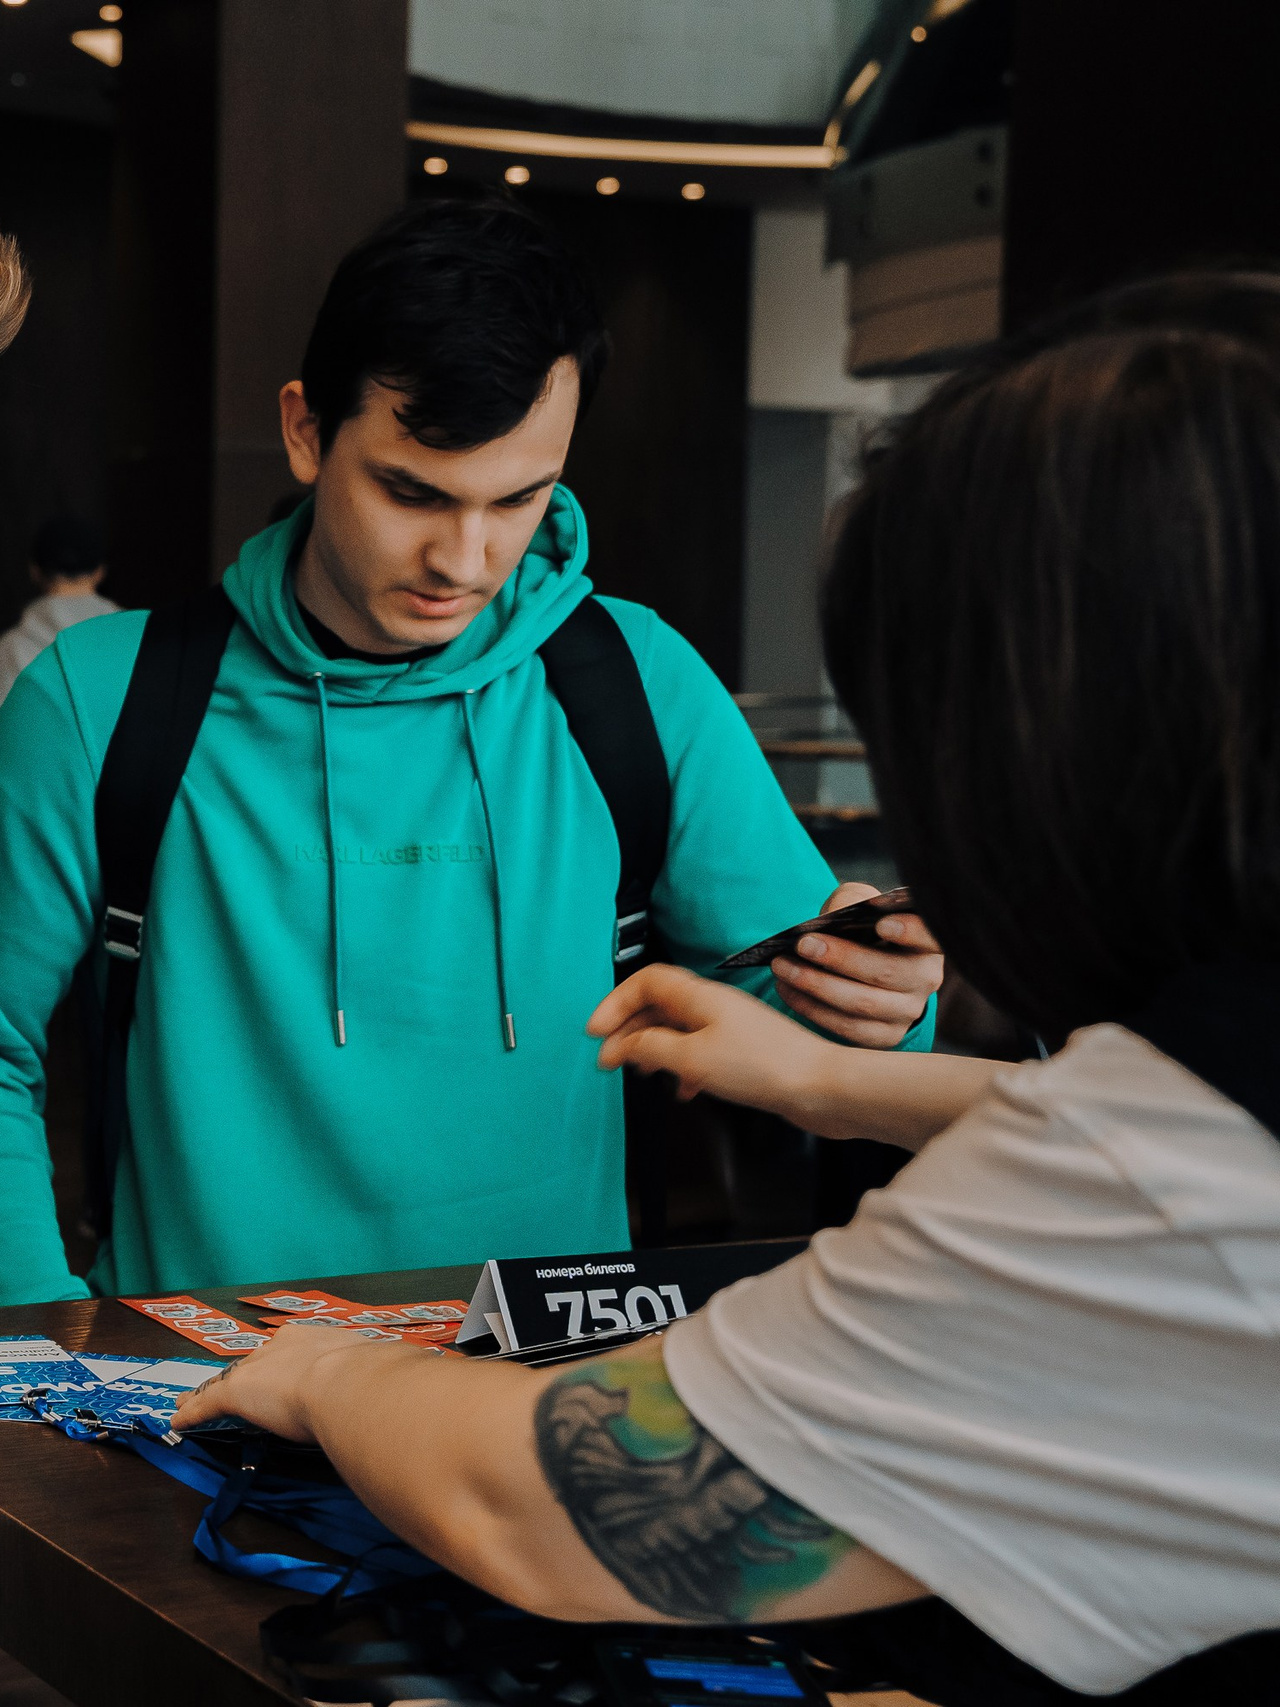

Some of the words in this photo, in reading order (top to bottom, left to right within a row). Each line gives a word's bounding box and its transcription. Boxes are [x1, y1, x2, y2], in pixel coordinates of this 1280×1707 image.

[358, 843, 485, 866] LAGERFELD
[536, 1264, 583, 1278] номера
[584, 1262, 636, 1276] билетов
[545, 1284, 687, 1337] 7501
